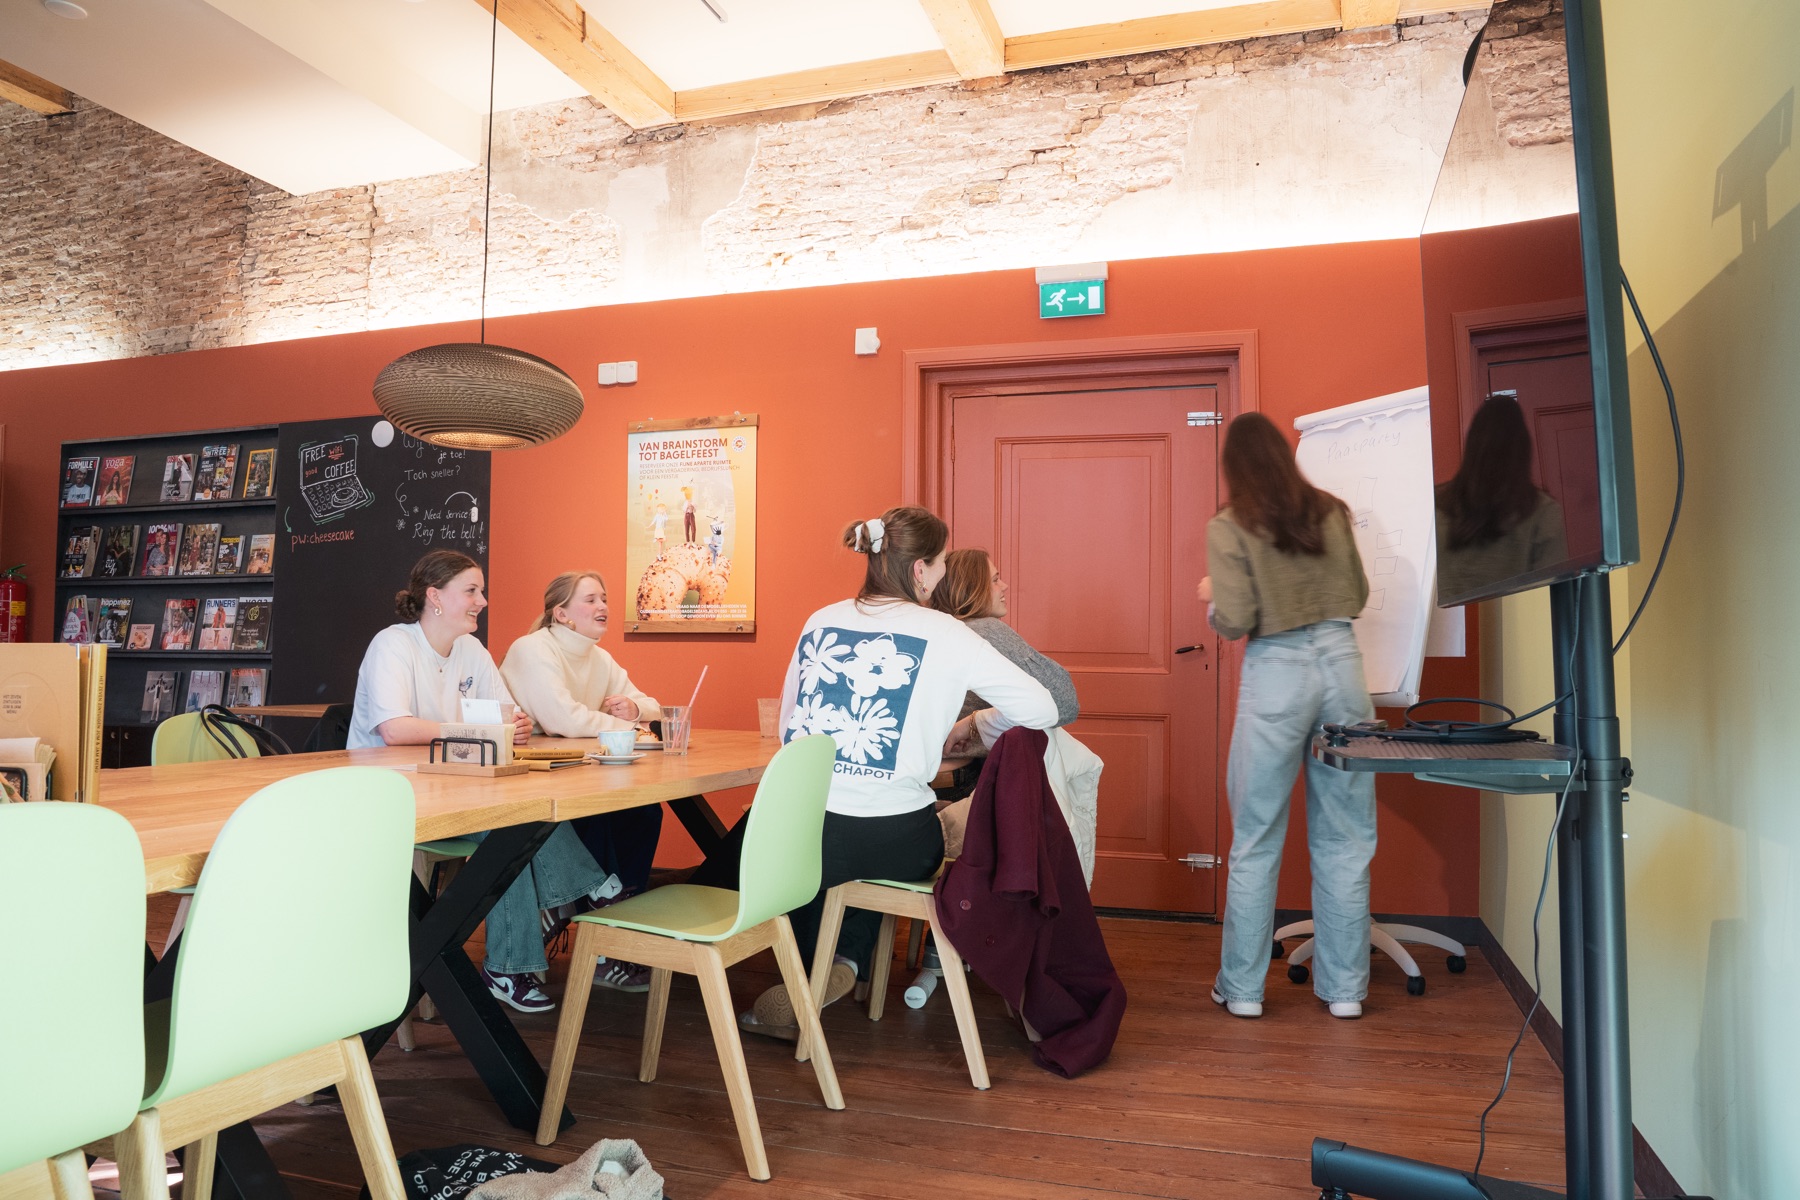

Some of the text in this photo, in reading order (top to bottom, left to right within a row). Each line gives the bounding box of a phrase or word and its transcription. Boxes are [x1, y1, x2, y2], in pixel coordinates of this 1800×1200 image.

[639, 441, 660, 451] VAN
[662, 438, 728, 450] BRAINSTORM
[305, 445, 343, 464] FREE wifi
[437, 449, 466, 465] je toe!
[639, 449, 719, 461] TOT BAGELFEEST
[67, 460, 93, 470] FORMULE
[105, 458, 125, 470] yoga
[305, 459, 355, 479] good COFFEE
[404, 464, 461, 481] Toch sneller?
[423, 508, 441, 520] Need
[412, 522, 435, 546] Ring
[440, 524, 456, 539] the
[101, 597, 131, 607] happinez
[833, 762, 895, 781] CHAPOT
